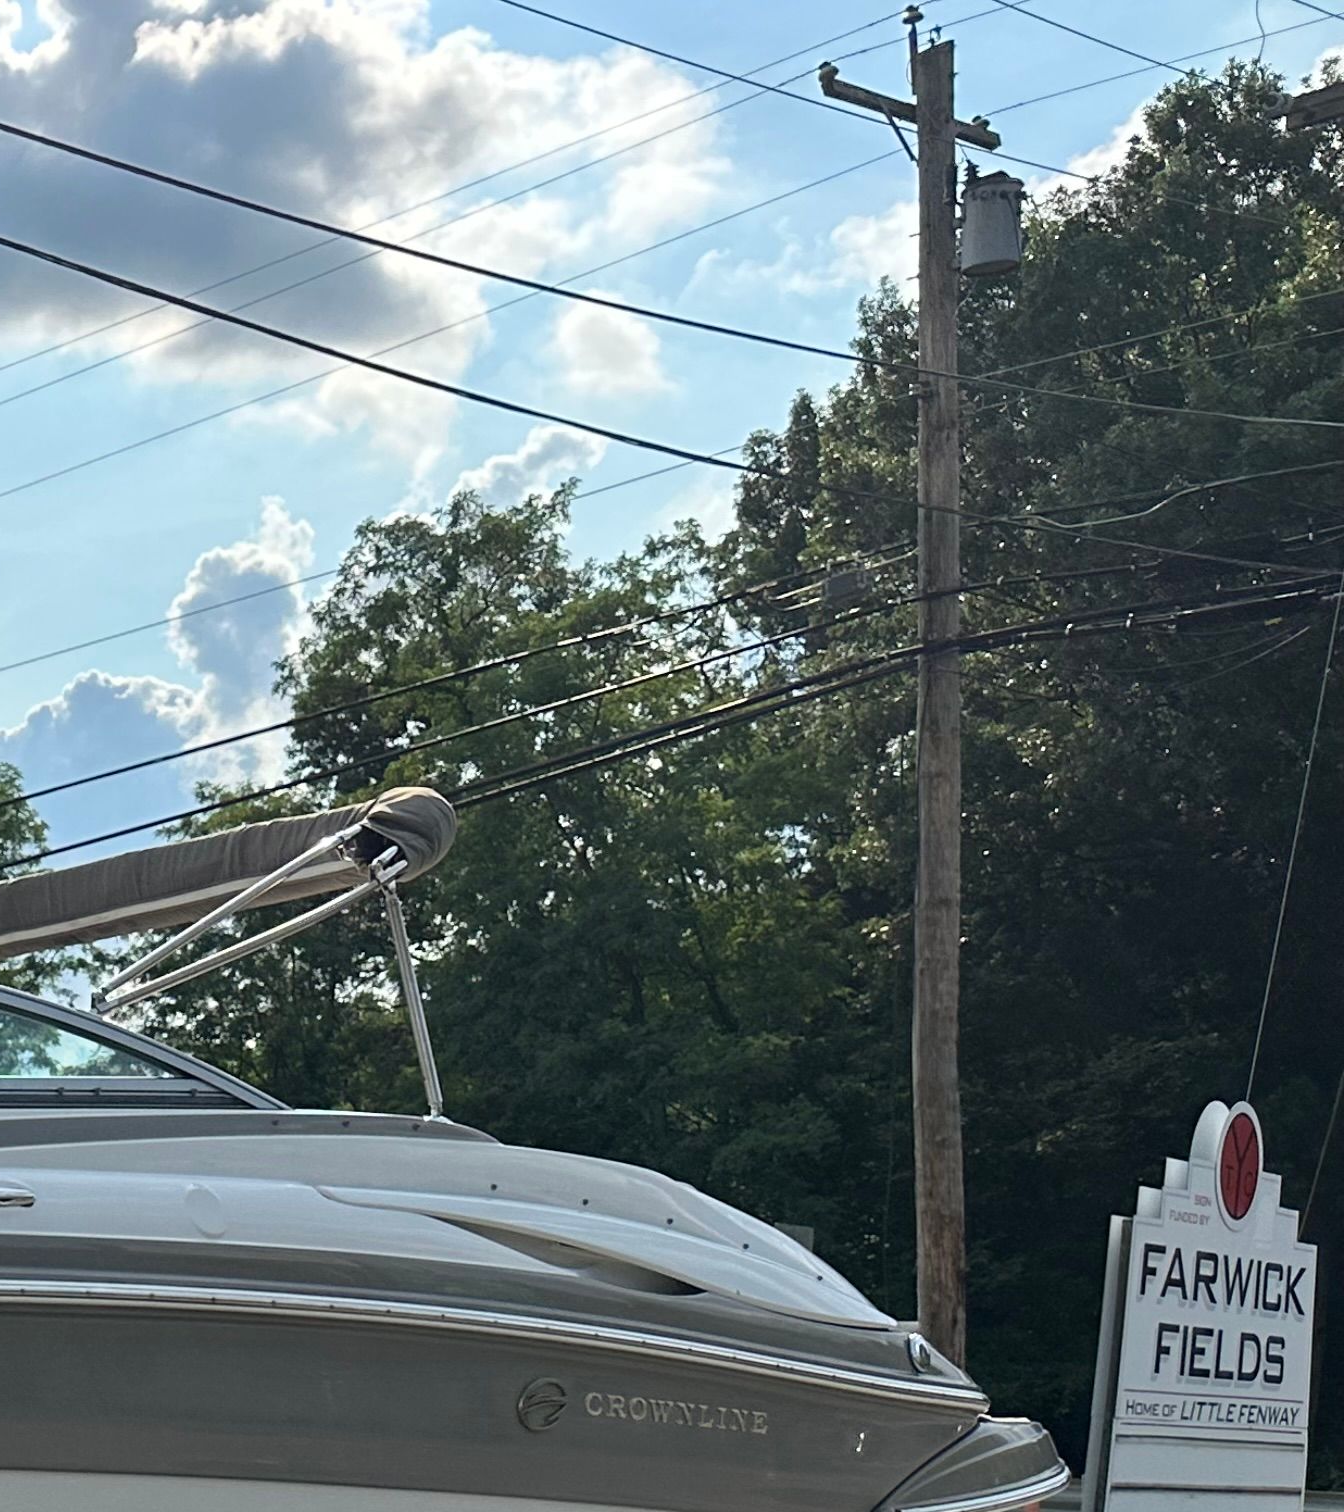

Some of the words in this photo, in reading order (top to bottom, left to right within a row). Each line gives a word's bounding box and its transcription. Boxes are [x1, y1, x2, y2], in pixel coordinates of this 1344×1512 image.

[1139, 1242, 1307, 1316] FARWICK
[1154, 1321, 1286, 1385] FIELDS
[584, 1391, 769, 1435] CROWNLINE
[1162, 1403, 1177, 1418] OF
[1180, 1400, 1237, 1423] LITTLE
[1238, 1404, 1300, 1426] FENWAY
